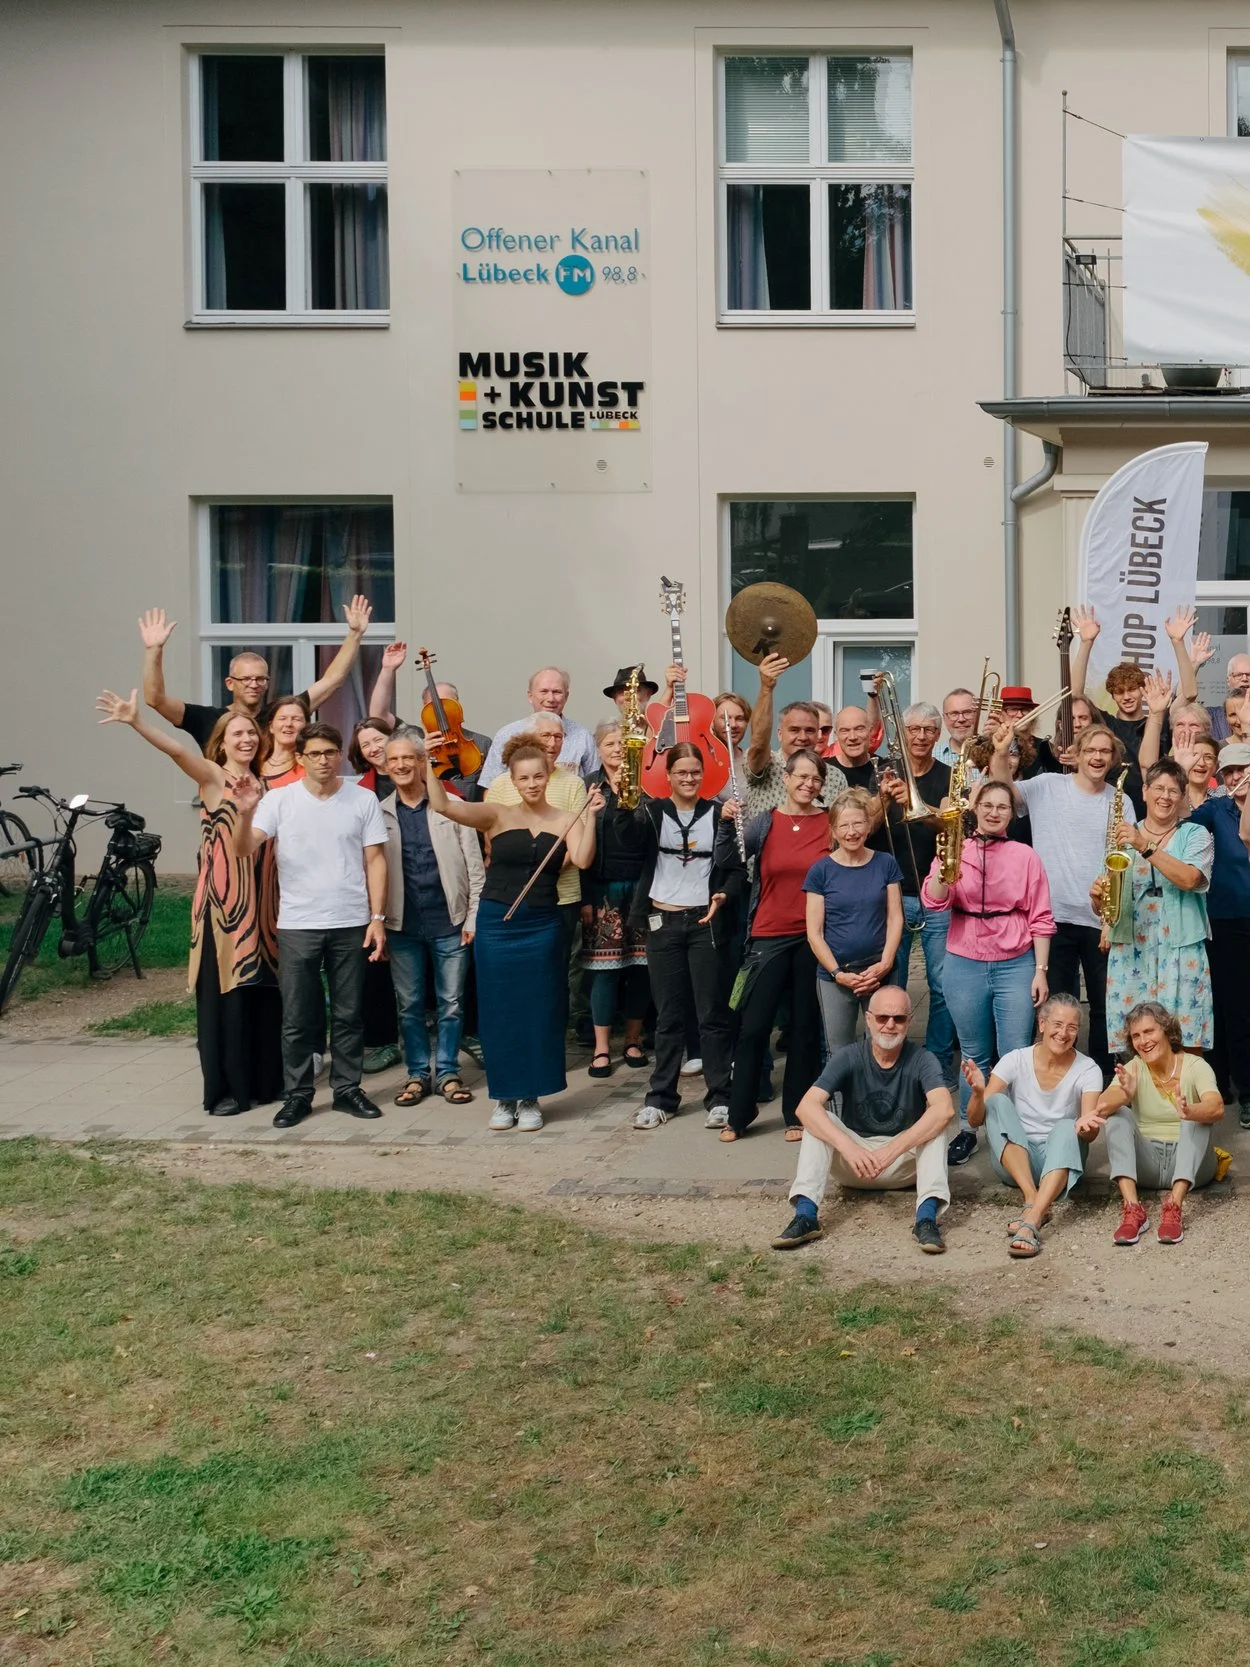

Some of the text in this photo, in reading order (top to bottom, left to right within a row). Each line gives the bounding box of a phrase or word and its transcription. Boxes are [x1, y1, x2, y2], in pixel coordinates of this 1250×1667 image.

[461, 227, 640, 252] Offener Kanal
[462, 263, 637, 284] Lübeck FM 98,8
[459, 352, 590, 378] MUSIK
[510, 381, 645, 408] KUNST
[482, 411, 586, 430] SCHULE
[1119, 496, 1168, 604] LÜBECK
